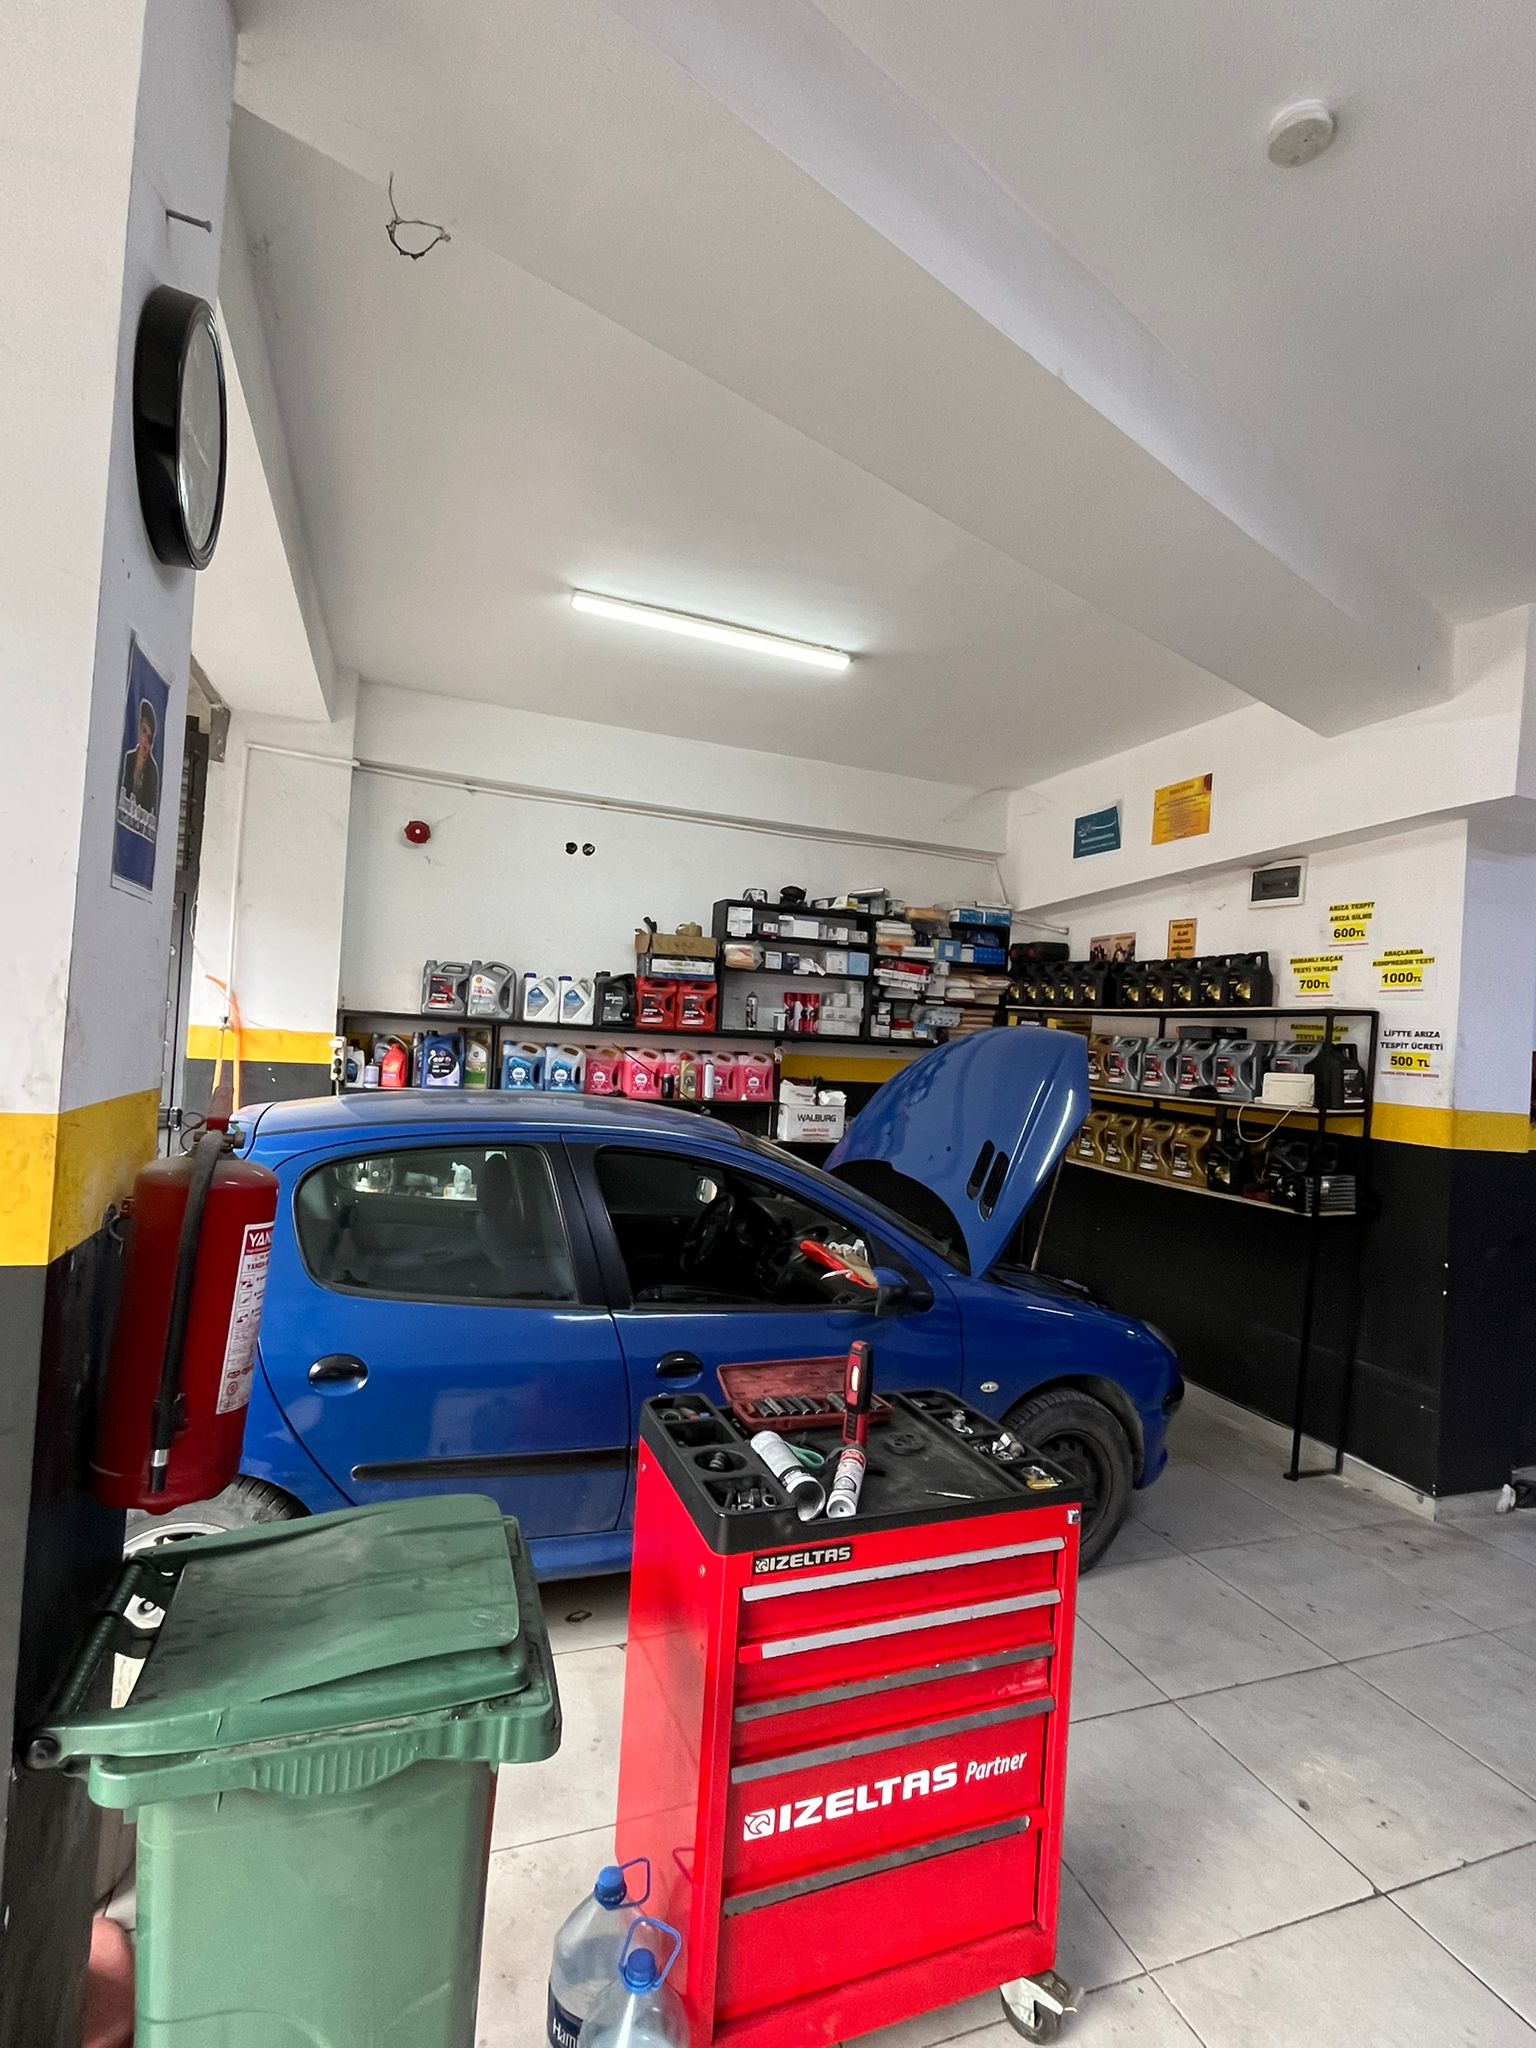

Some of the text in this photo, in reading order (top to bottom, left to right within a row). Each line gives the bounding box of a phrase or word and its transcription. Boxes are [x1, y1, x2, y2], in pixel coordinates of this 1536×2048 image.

[1333, 928, 1365, 938] 600TL
[1382, 972, 1422, 983] 1000TL
[1299, 979, 1330, 989] 700TL
[1383, 1029, 1441, 1039] LİFTTE ARIZA
[1380, 1041, 1444, 1051] TESPİT ÜCRETİ
[1390, 1055, 1430, 1068] 500 TL
[797, 1113, 837, 1123] WALBURG
[769, 1546, 851, 1571] IZELTAS
[778, 1752, 1028, 1833] IZELTAS Partner
